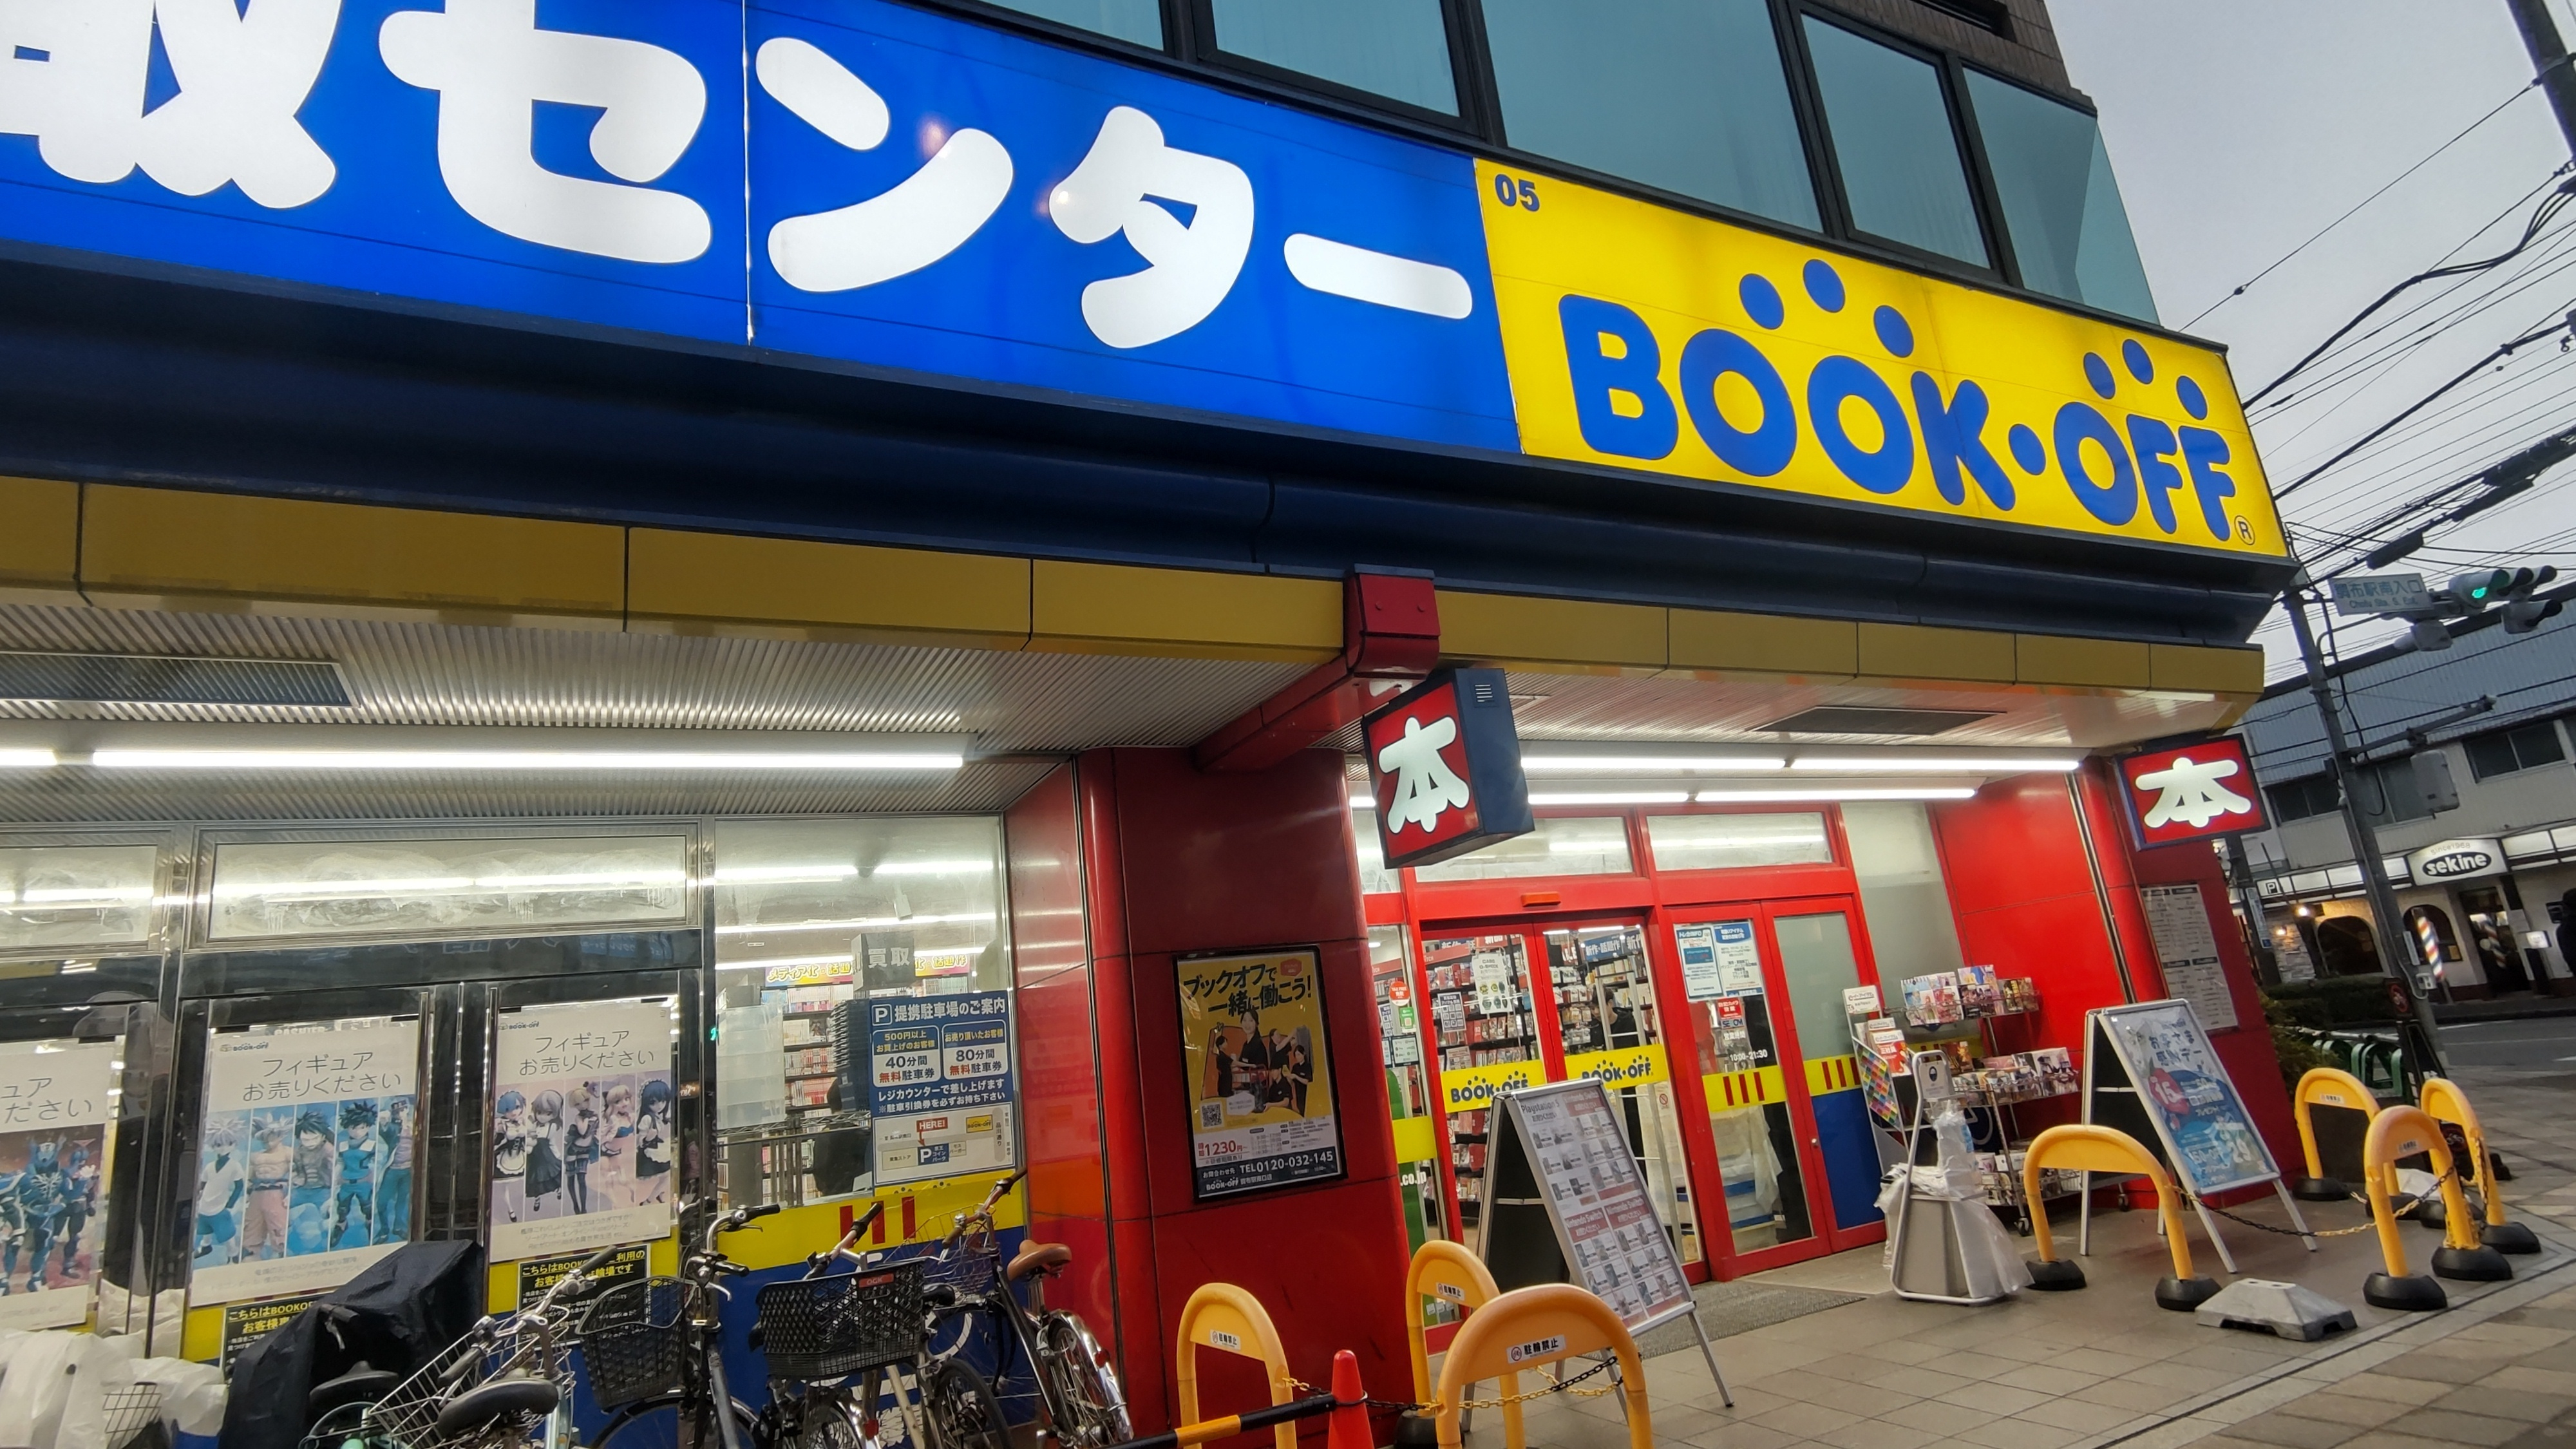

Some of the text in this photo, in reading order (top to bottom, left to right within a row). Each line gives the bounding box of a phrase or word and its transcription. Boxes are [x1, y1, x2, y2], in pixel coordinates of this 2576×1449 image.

[1495, 174, 1540, 212] 05
[1378, 716, 1470, 834] 本
[2135, 757, 2252, 828] 本
[2426, 854, 2487, 875] sekine
[868, 947, 911, 968] 買取
[1184, 963, 1278, 998] ブックオフで
[875, 1007, 888, 1023] P
[895, 997, 1006, 1022] 提携駐車場のご案内
[535, 1030, 630, 1054] フィギュア
[876, 1039, 936, 1053] お買上げのお客様
[884, 1030, 927, 1041] 500円以上
[263, 1052, 374, 1077] フィギュア
[519, 1050, 654, 1076] お売りください
[885, 1055, 928, 1069] 40分間
[956, 1048, 996, 1063] 80分間
[878, 1068, 935, 1084] 無料駐車券
[949, 1060, 1003, 1076] 無料駐車券
[243, 1073, 401, 1102] お売りください
[878, 1078, 1005, 1102] レジカウンターで差し上げます
[5, 1099, 92, 1123] ださい
[919, 1119, 946, 1130] HERE!
[920, 1148, 932, 1163] P
[1524, 1338, 1558, 1355] 駐輪禁止
